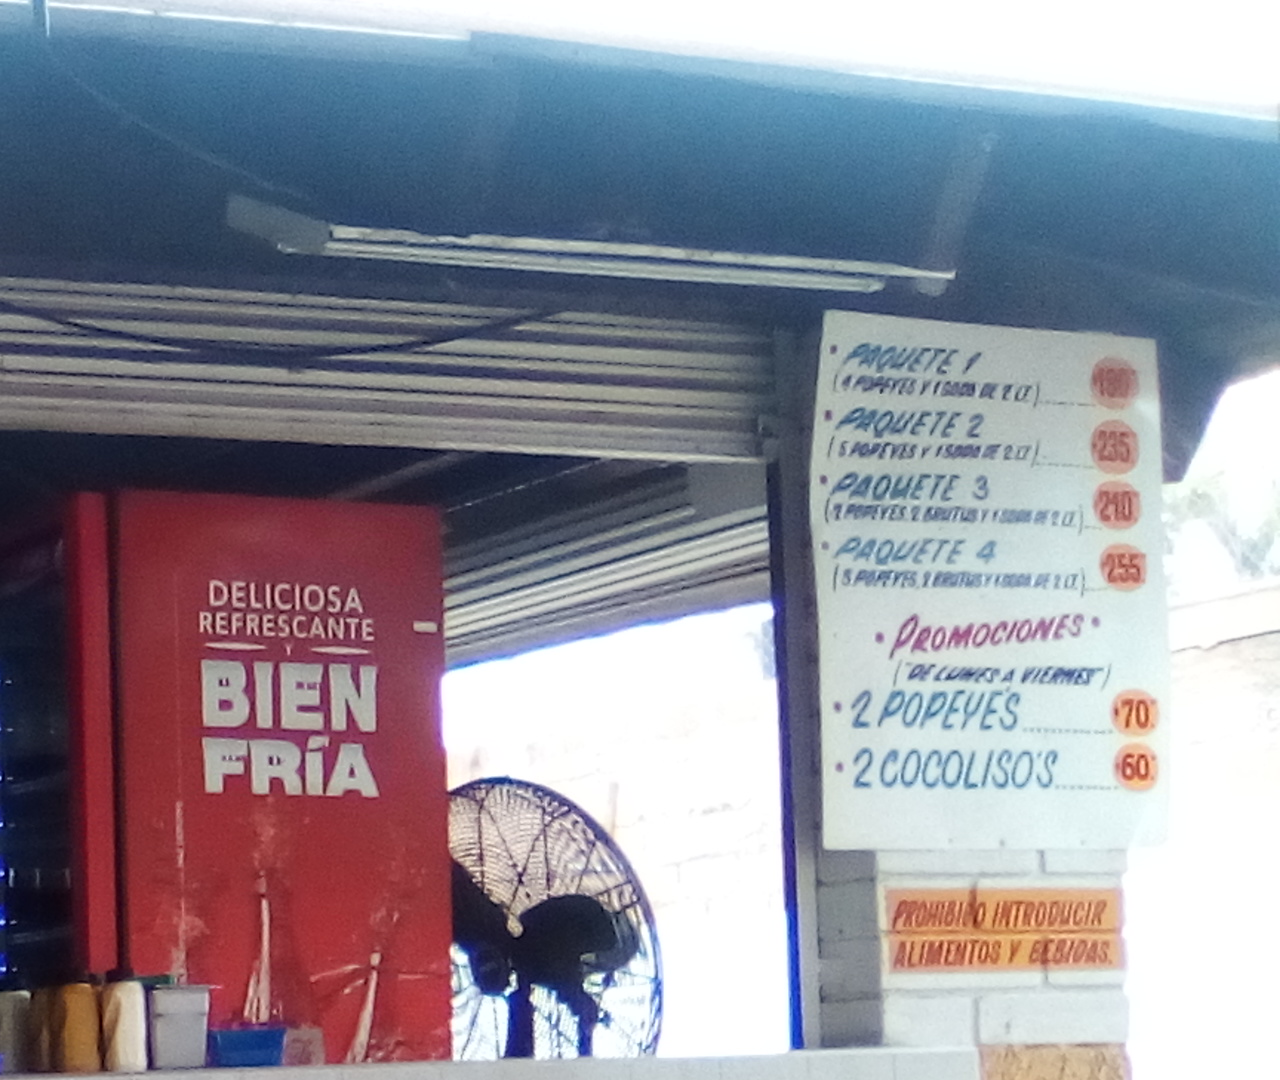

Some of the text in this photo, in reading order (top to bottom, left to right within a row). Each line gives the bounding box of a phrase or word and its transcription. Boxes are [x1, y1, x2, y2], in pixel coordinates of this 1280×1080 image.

[842, 342, 982, 375] PAQUETE 1
[835, 407, 985, 439] PAQUETE 2
[830, 472, 990, 501] PAQUETE 3
[833, 536, 997, 566] PAQUETE 4
[208, 579, 363, 614] DELICIOSA
[199, 611, 375, 641] REFRESCANTE
[889, 613, 1085, 660] PROMOCIONES
[934, 665, 1000, 683] LUNES
[1001, 668, 1015, 683] A
[200, 659, 378, 733] BIEN
[851, 686, 1021, 731] 2 POPEYE'S
[201, 735, 379, 798] FRÍA
[852, 748, 1058, 790] 2 COCOLISO'S
[992, 900, 1108, 928] INTRODUCIR
[893, 939, 1000, 968] ALIMENTOS
[1007, 940, 1022, 964] Y
